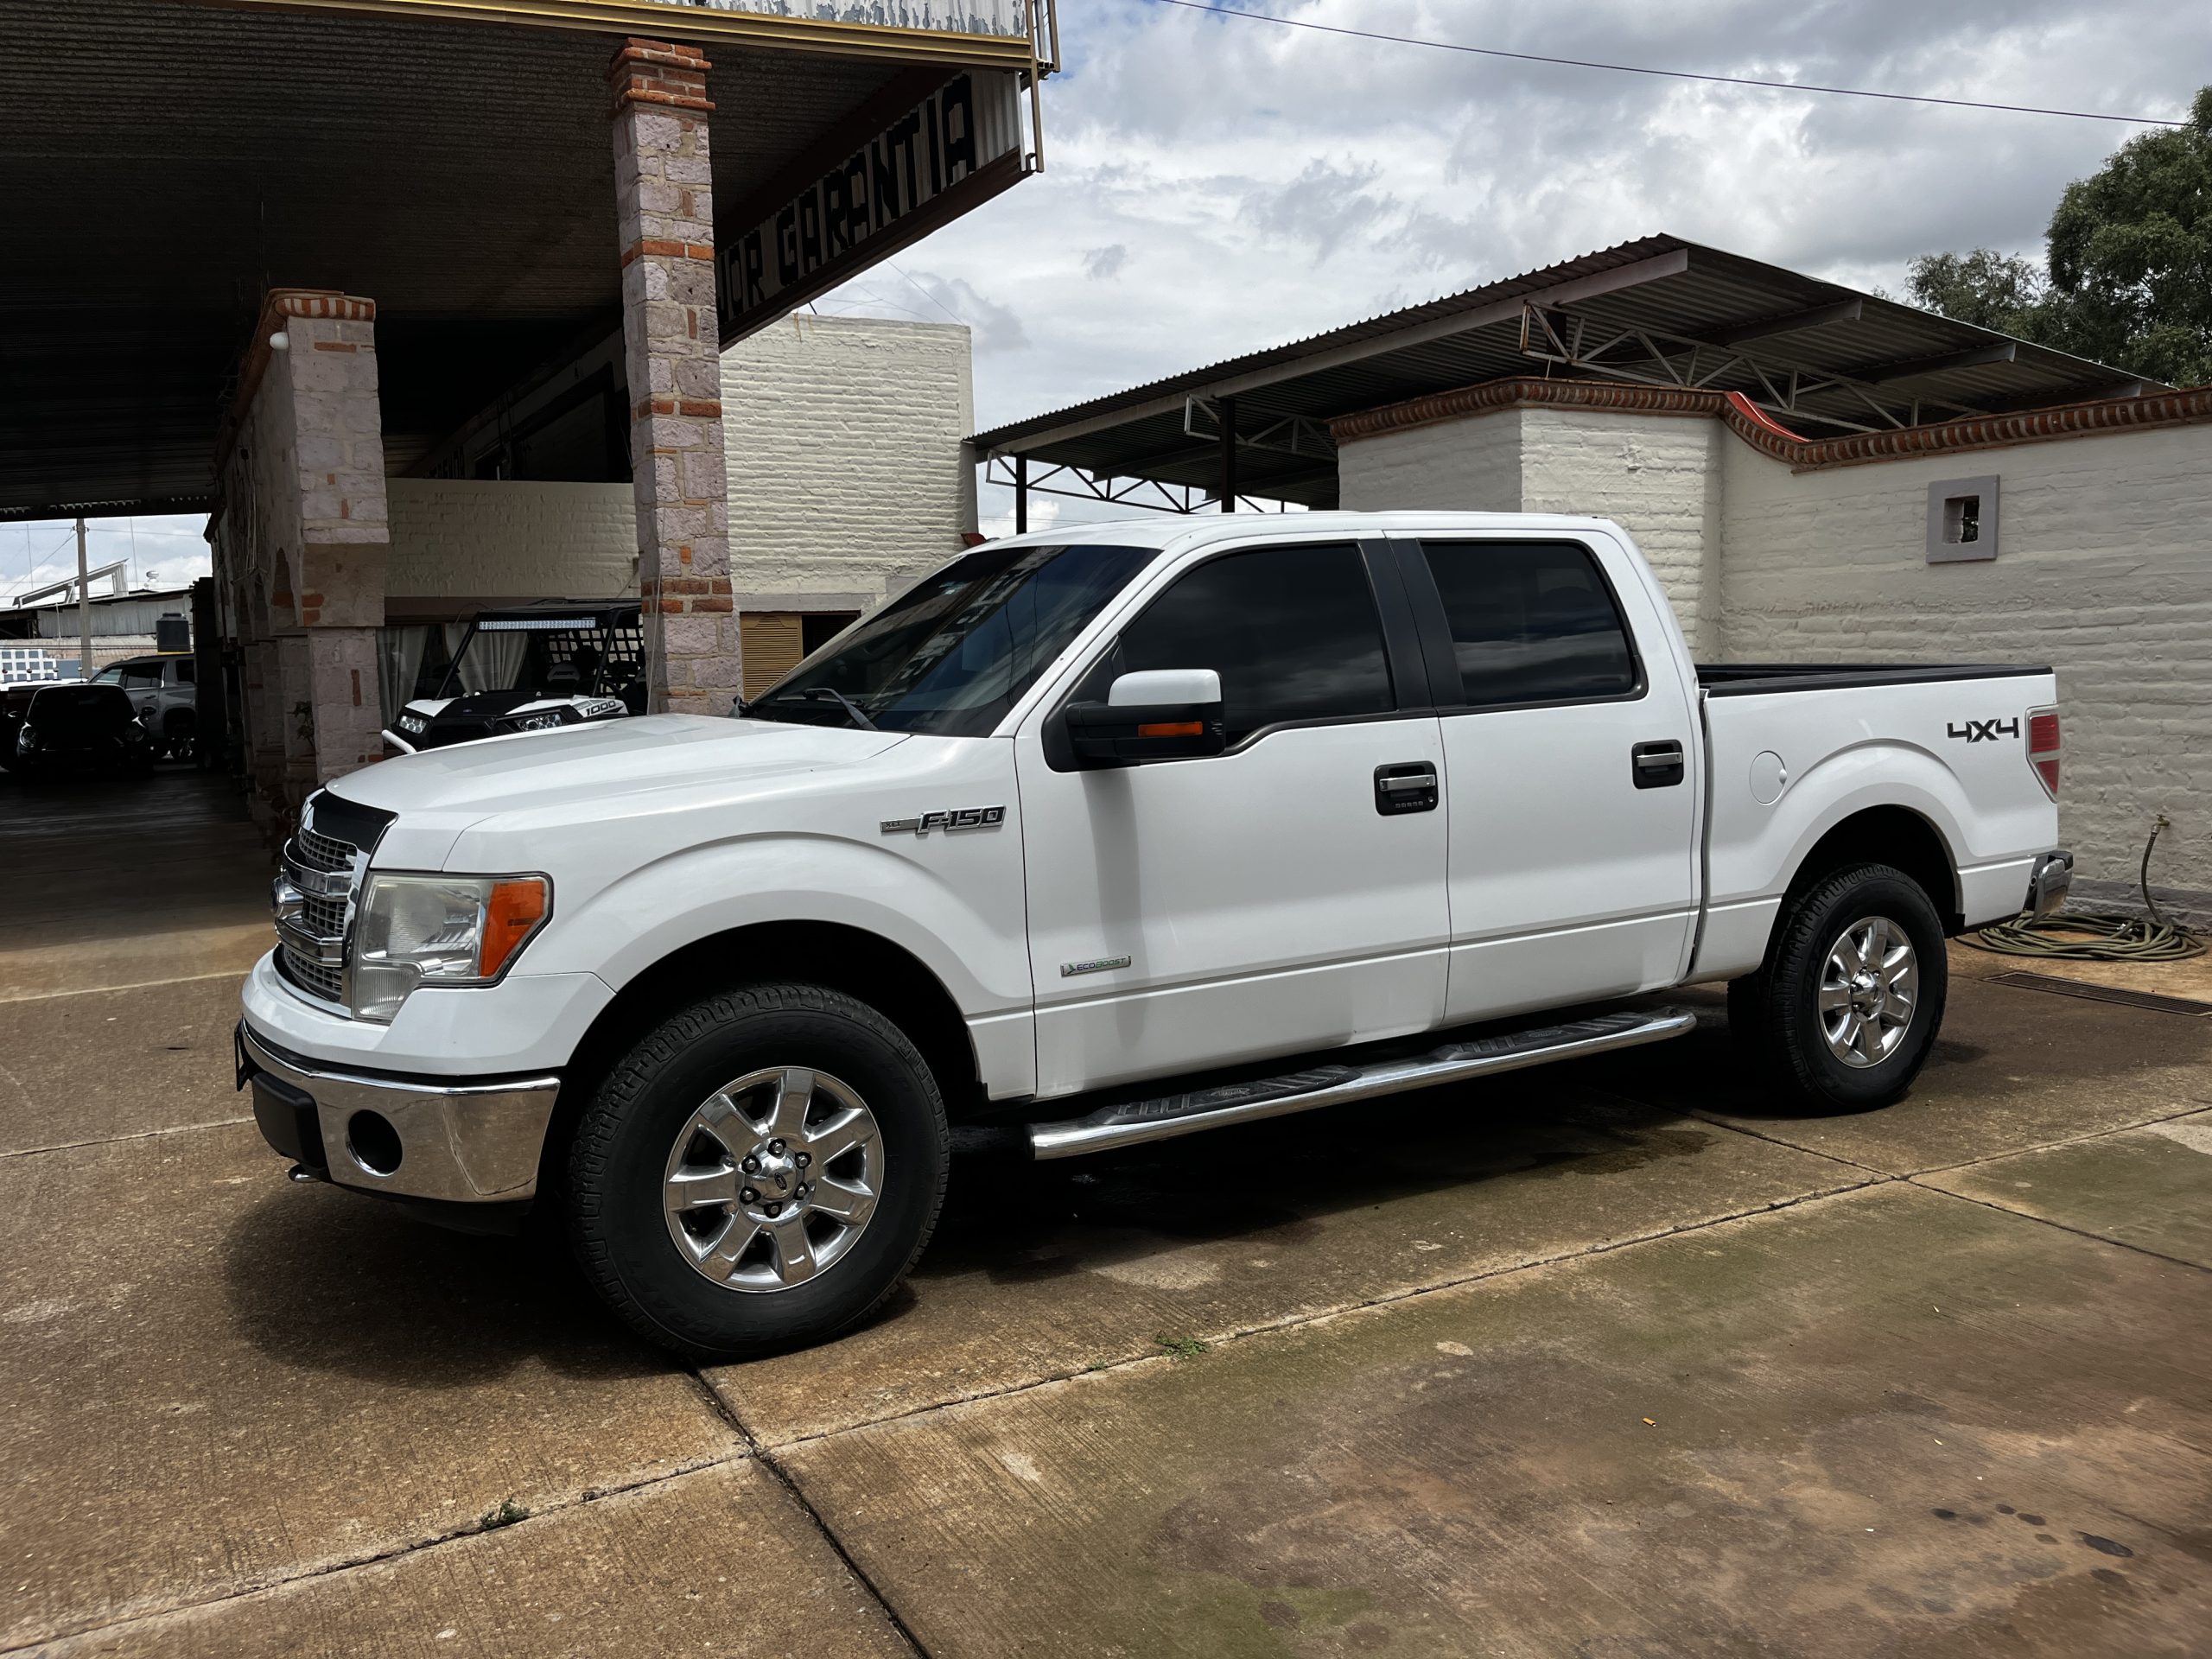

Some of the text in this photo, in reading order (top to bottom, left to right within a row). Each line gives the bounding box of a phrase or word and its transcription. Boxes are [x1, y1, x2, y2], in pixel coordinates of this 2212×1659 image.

[776, 72, 977, 287] GARANTIA
[586, 700, 616, 716] 1000
[916, 805, 1006, 835] F-150
